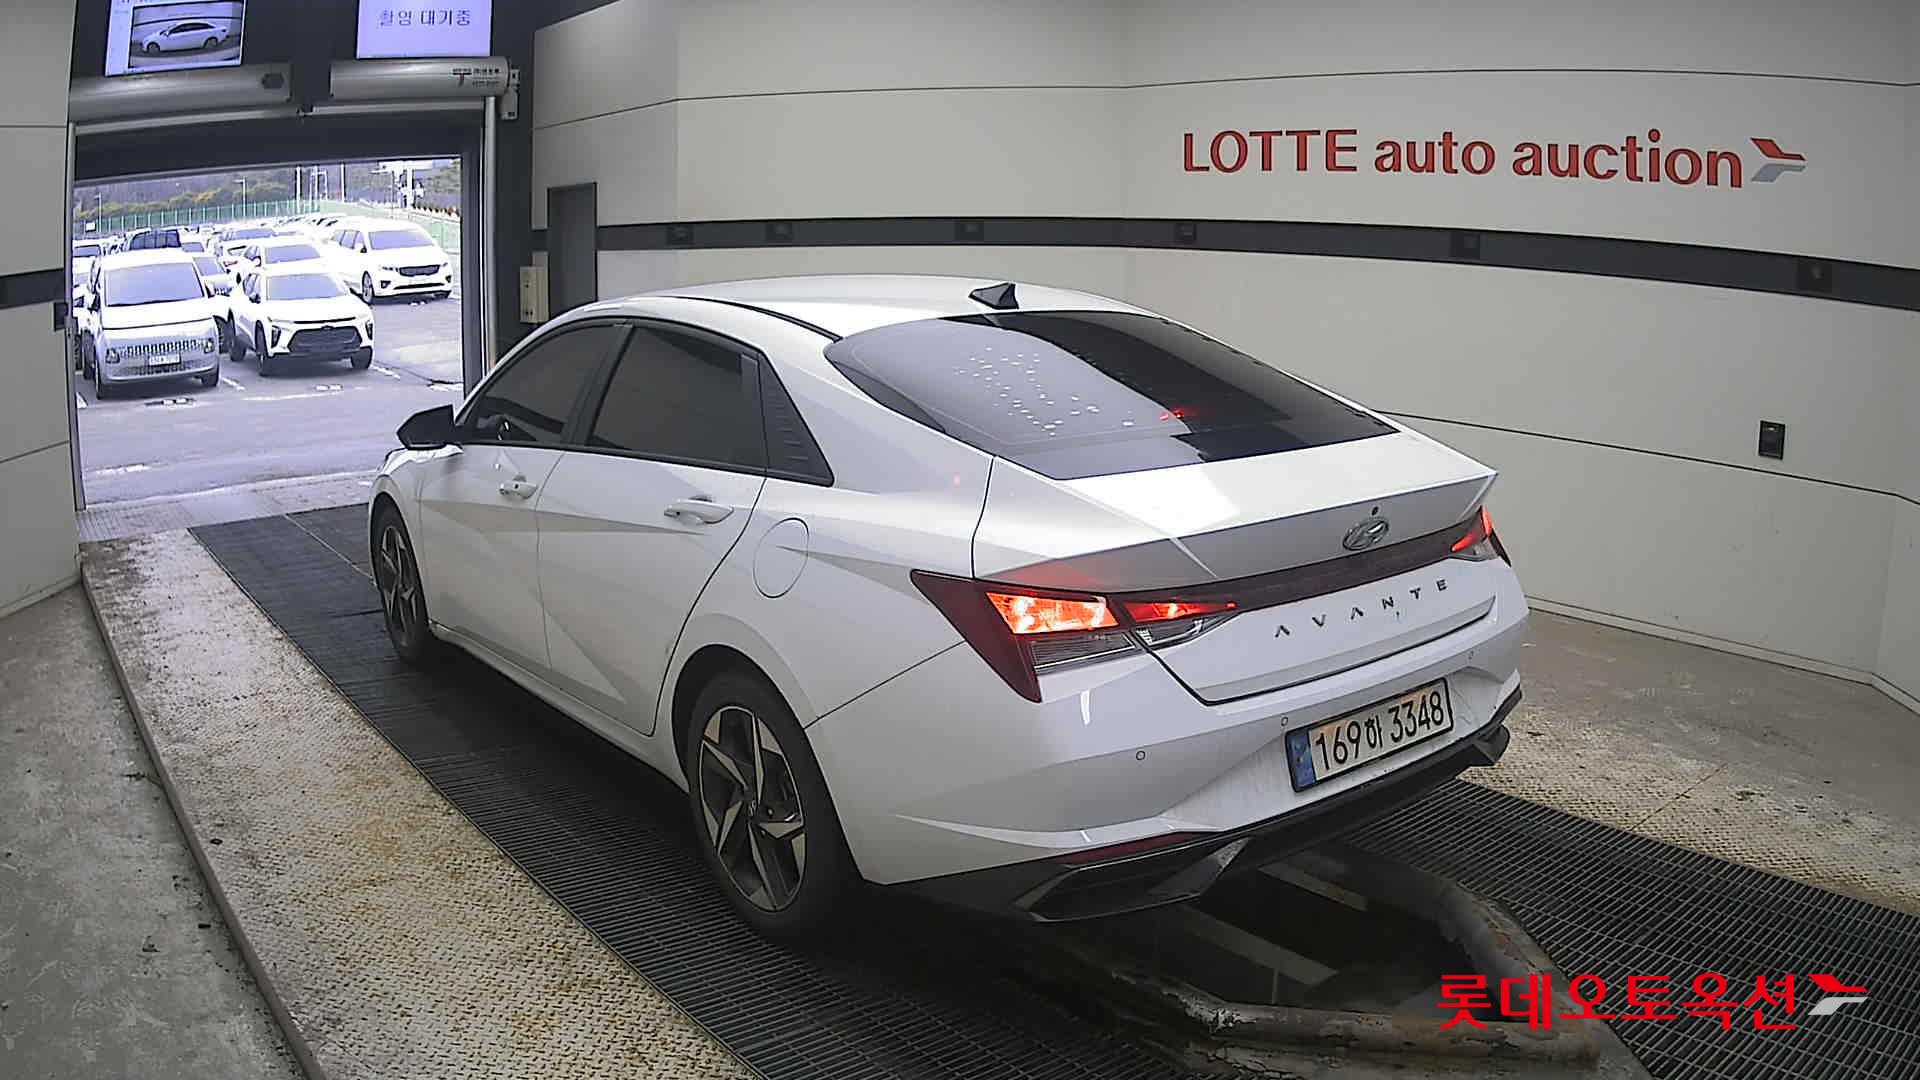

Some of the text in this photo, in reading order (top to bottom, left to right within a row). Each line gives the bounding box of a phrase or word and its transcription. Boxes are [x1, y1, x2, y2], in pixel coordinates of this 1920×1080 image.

[1184, 129, 1744, 189] LOTTE auto auction
[1275, 579, 1447, 638] AVANTE
[1315, 691, 1444, 771] 169하 3348
